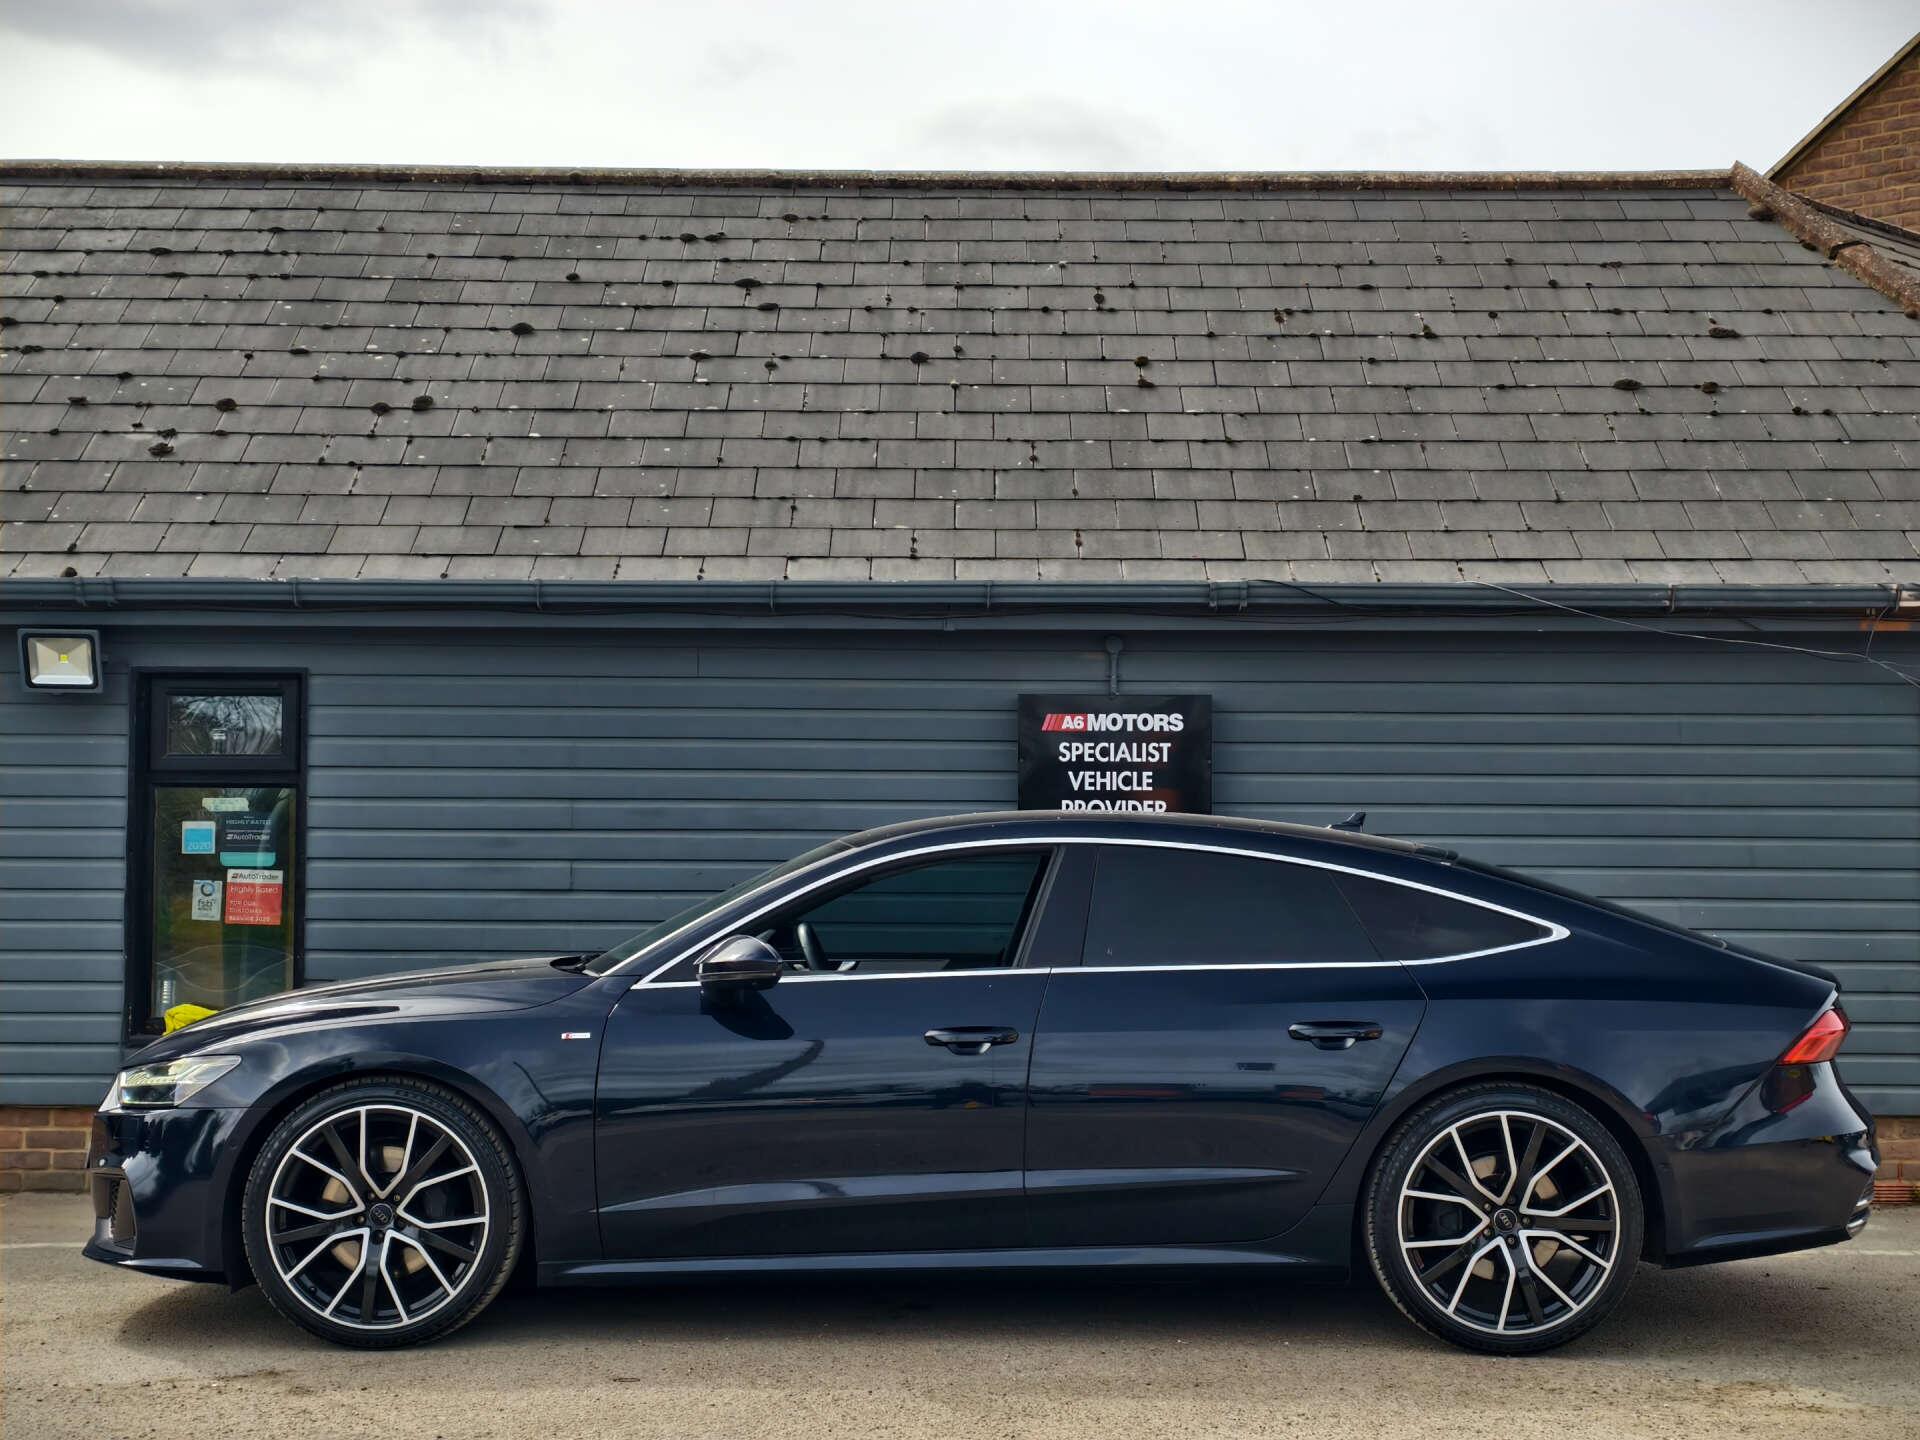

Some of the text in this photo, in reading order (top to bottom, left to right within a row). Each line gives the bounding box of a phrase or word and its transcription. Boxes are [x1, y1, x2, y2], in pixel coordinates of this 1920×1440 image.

[1061, 713, 1184, 732] A6 MOTORS
[1058, 742, 1171, 763] SPECIALIST
[1067, 771, 1153, 791] VEHICLE
[1061, 800, 1167, 813] PROVIDER
